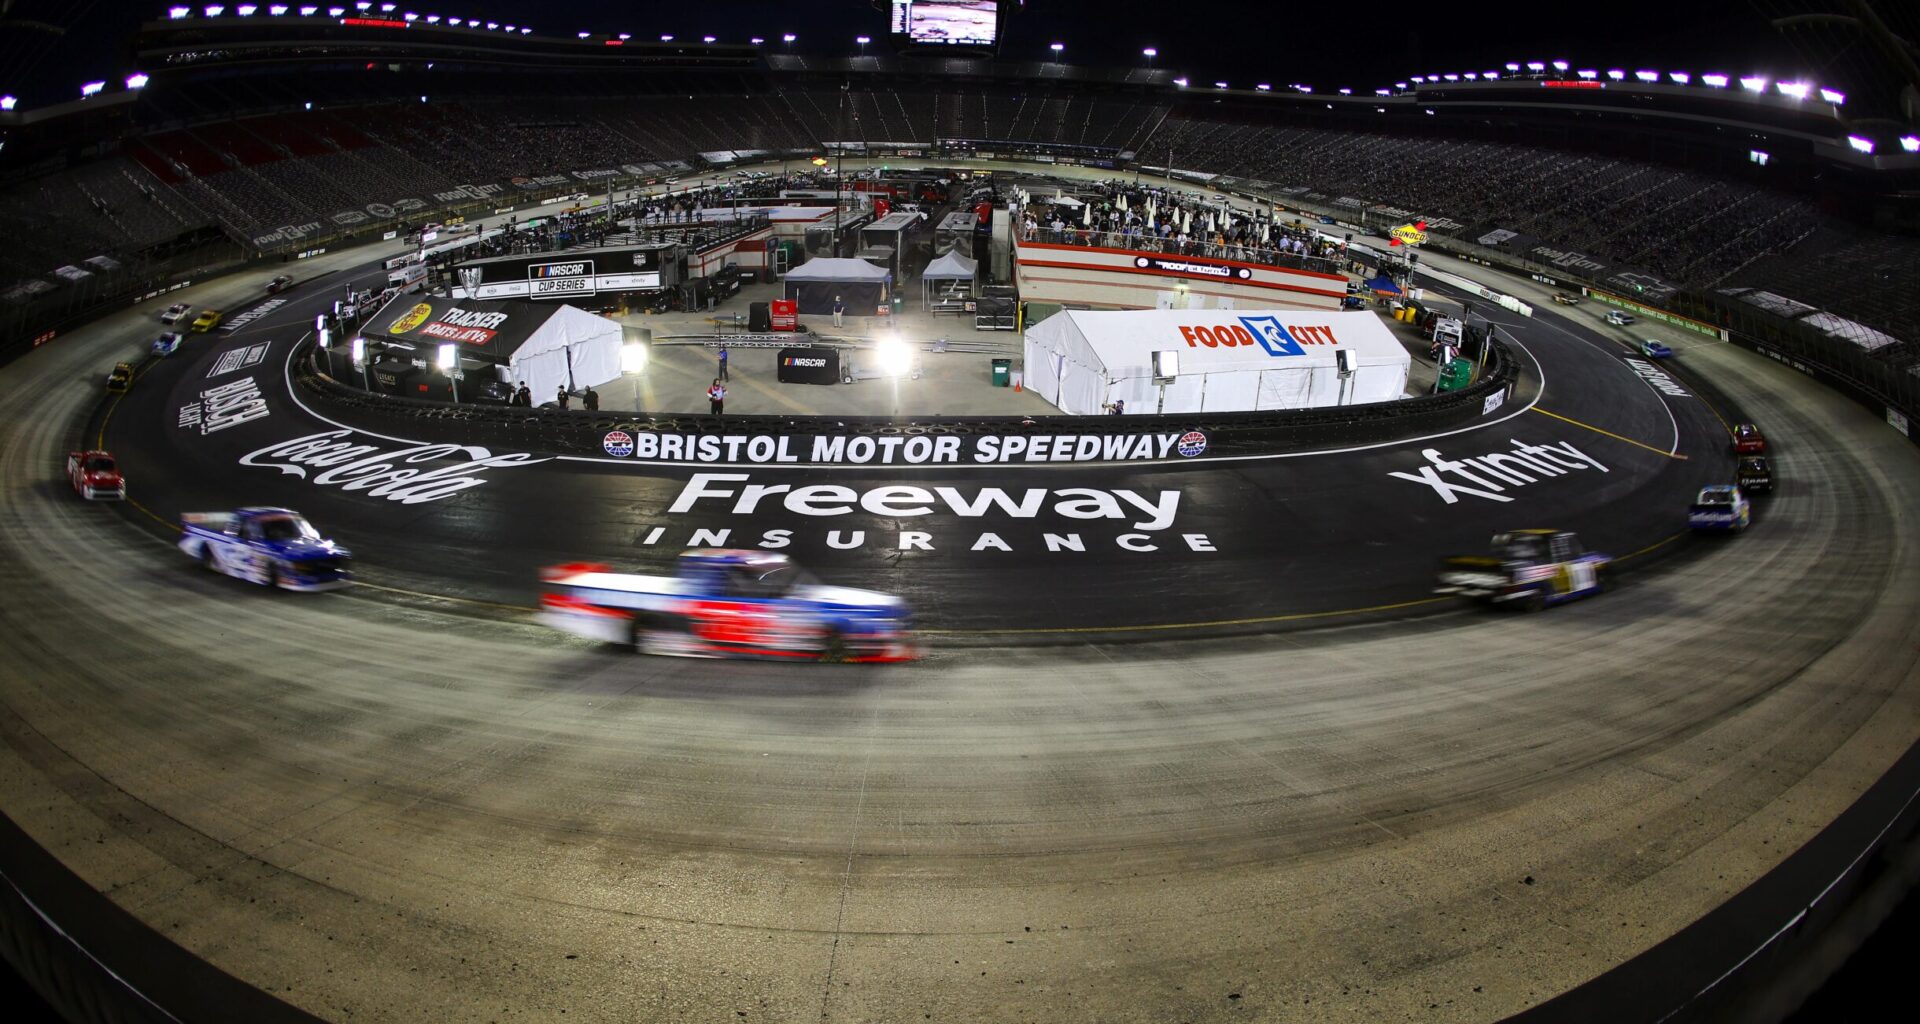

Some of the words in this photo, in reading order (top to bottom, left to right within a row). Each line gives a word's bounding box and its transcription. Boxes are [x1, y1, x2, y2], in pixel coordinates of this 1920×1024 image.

[253, 232, 283, 247] FOOD
[299, 222, 321, 232] CITY
[1394, 229, 1426, 241] SUNOCO
[549, 264, 584, 276] NASCAR
[538, 282, 555, 291] CUP
[555, 280, 585, 290] SERIES
[440, 308, 508, 329] TRACKER
[424, 324, 457, 339] BOATS
[459, 330, 488, 342] ATVs
[1179, 326, 1255, 348] FOOD
[1287, 325, 1339, 345] CITY
[795, 358, 826, 367] NASCAR
[179, 402, 201, 428] LIGHT
[200, 376, 270, 435] BUSCH
[636, 432, 798, 463] BRISTOL
[811, 435, 961, 463] MOTOR
[973, 434, 1180, 463] SPEEDWAY
[1387, 439, 1609, 504] xfinity
[667, 473, 1181, 531] Freeway
[642, 527, 1218, 552] INSURANCE
